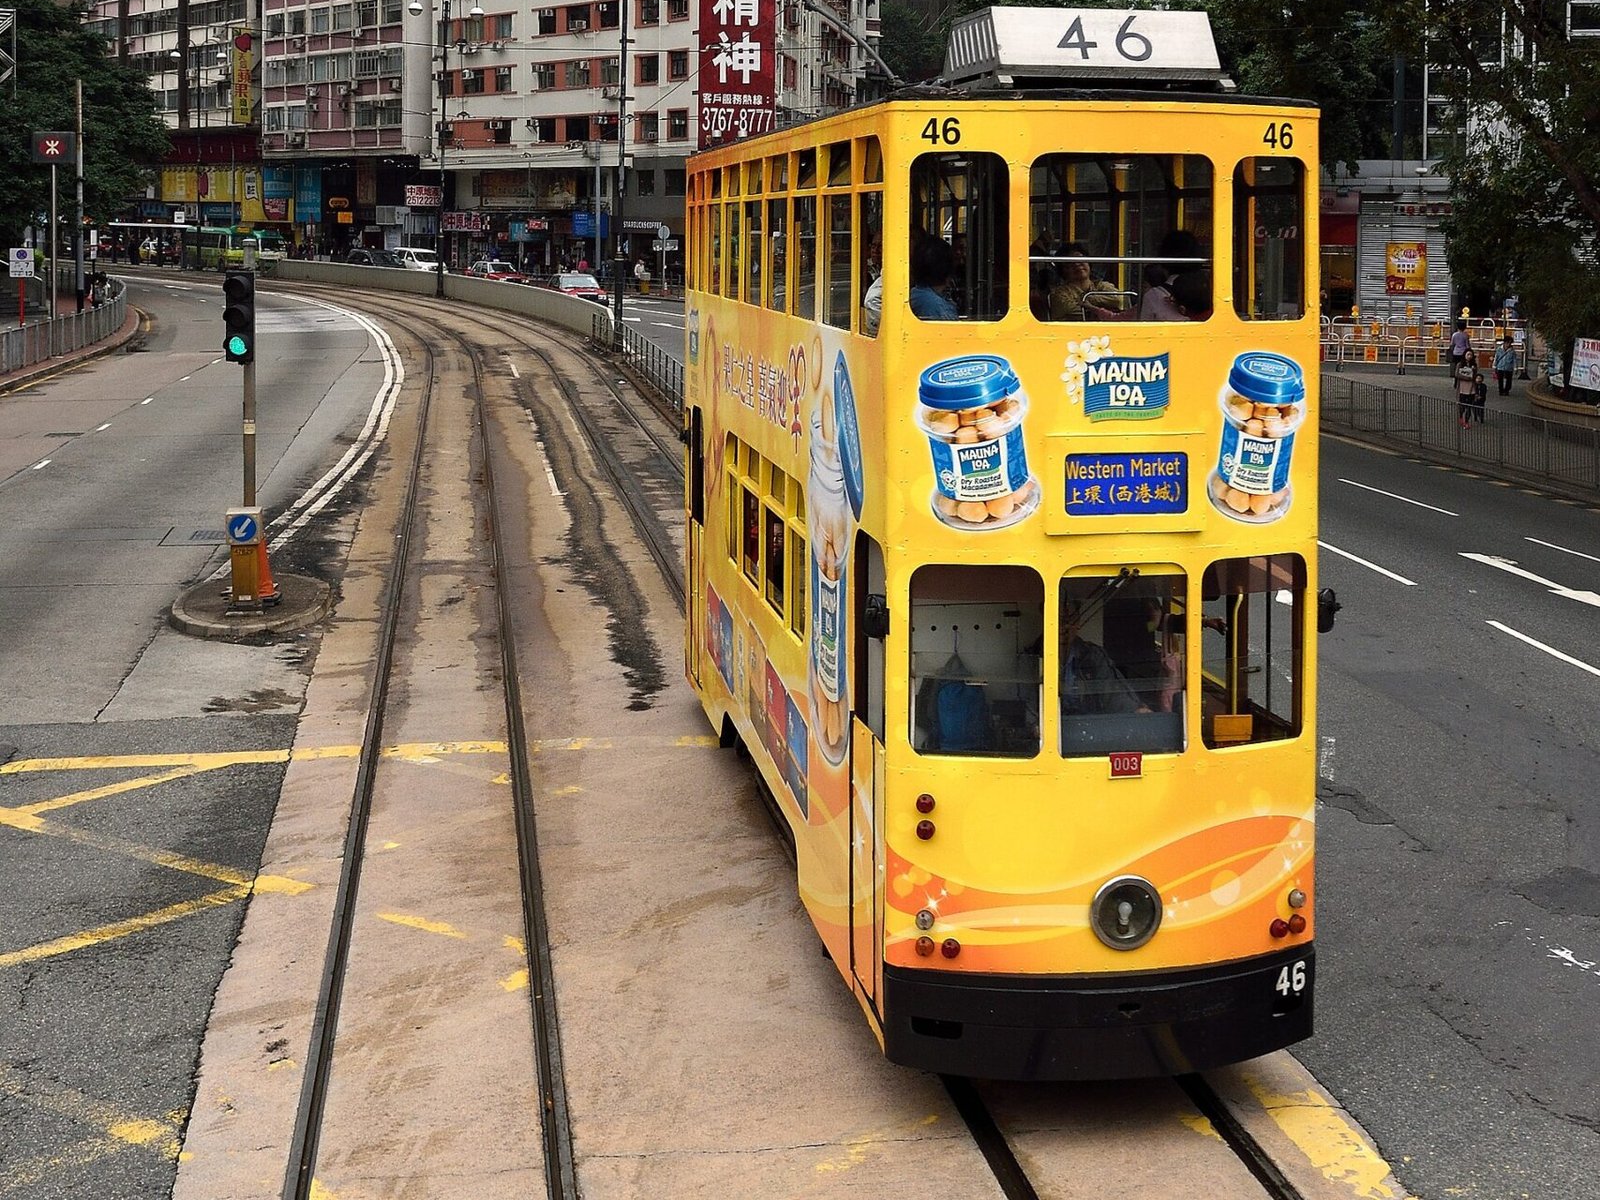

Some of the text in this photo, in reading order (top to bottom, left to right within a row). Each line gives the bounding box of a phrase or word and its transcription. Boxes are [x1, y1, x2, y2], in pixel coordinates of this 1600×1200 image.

[1057, 15, 1153, 62] 46
[702, 106, 772, 132] 3767-8777
[921, 117, 961, 145] 46
[1263, 122, 1293, 150] 46
[1088, 360, 1167, 387] MAUNA
[1109, 384, 1147, 406] LOA
[959, 445, 999, 462] MAUNA
[1243, 441, 1274, 453] MAUNA
[1249, 452, 1264, 464] LOA
[971, 459, 990, 471] LOA
[1066, 457, 1181, 479] Western Market
[1113, 756, 1139, 772] 003
[1275, 961, 1306, 996] 46
